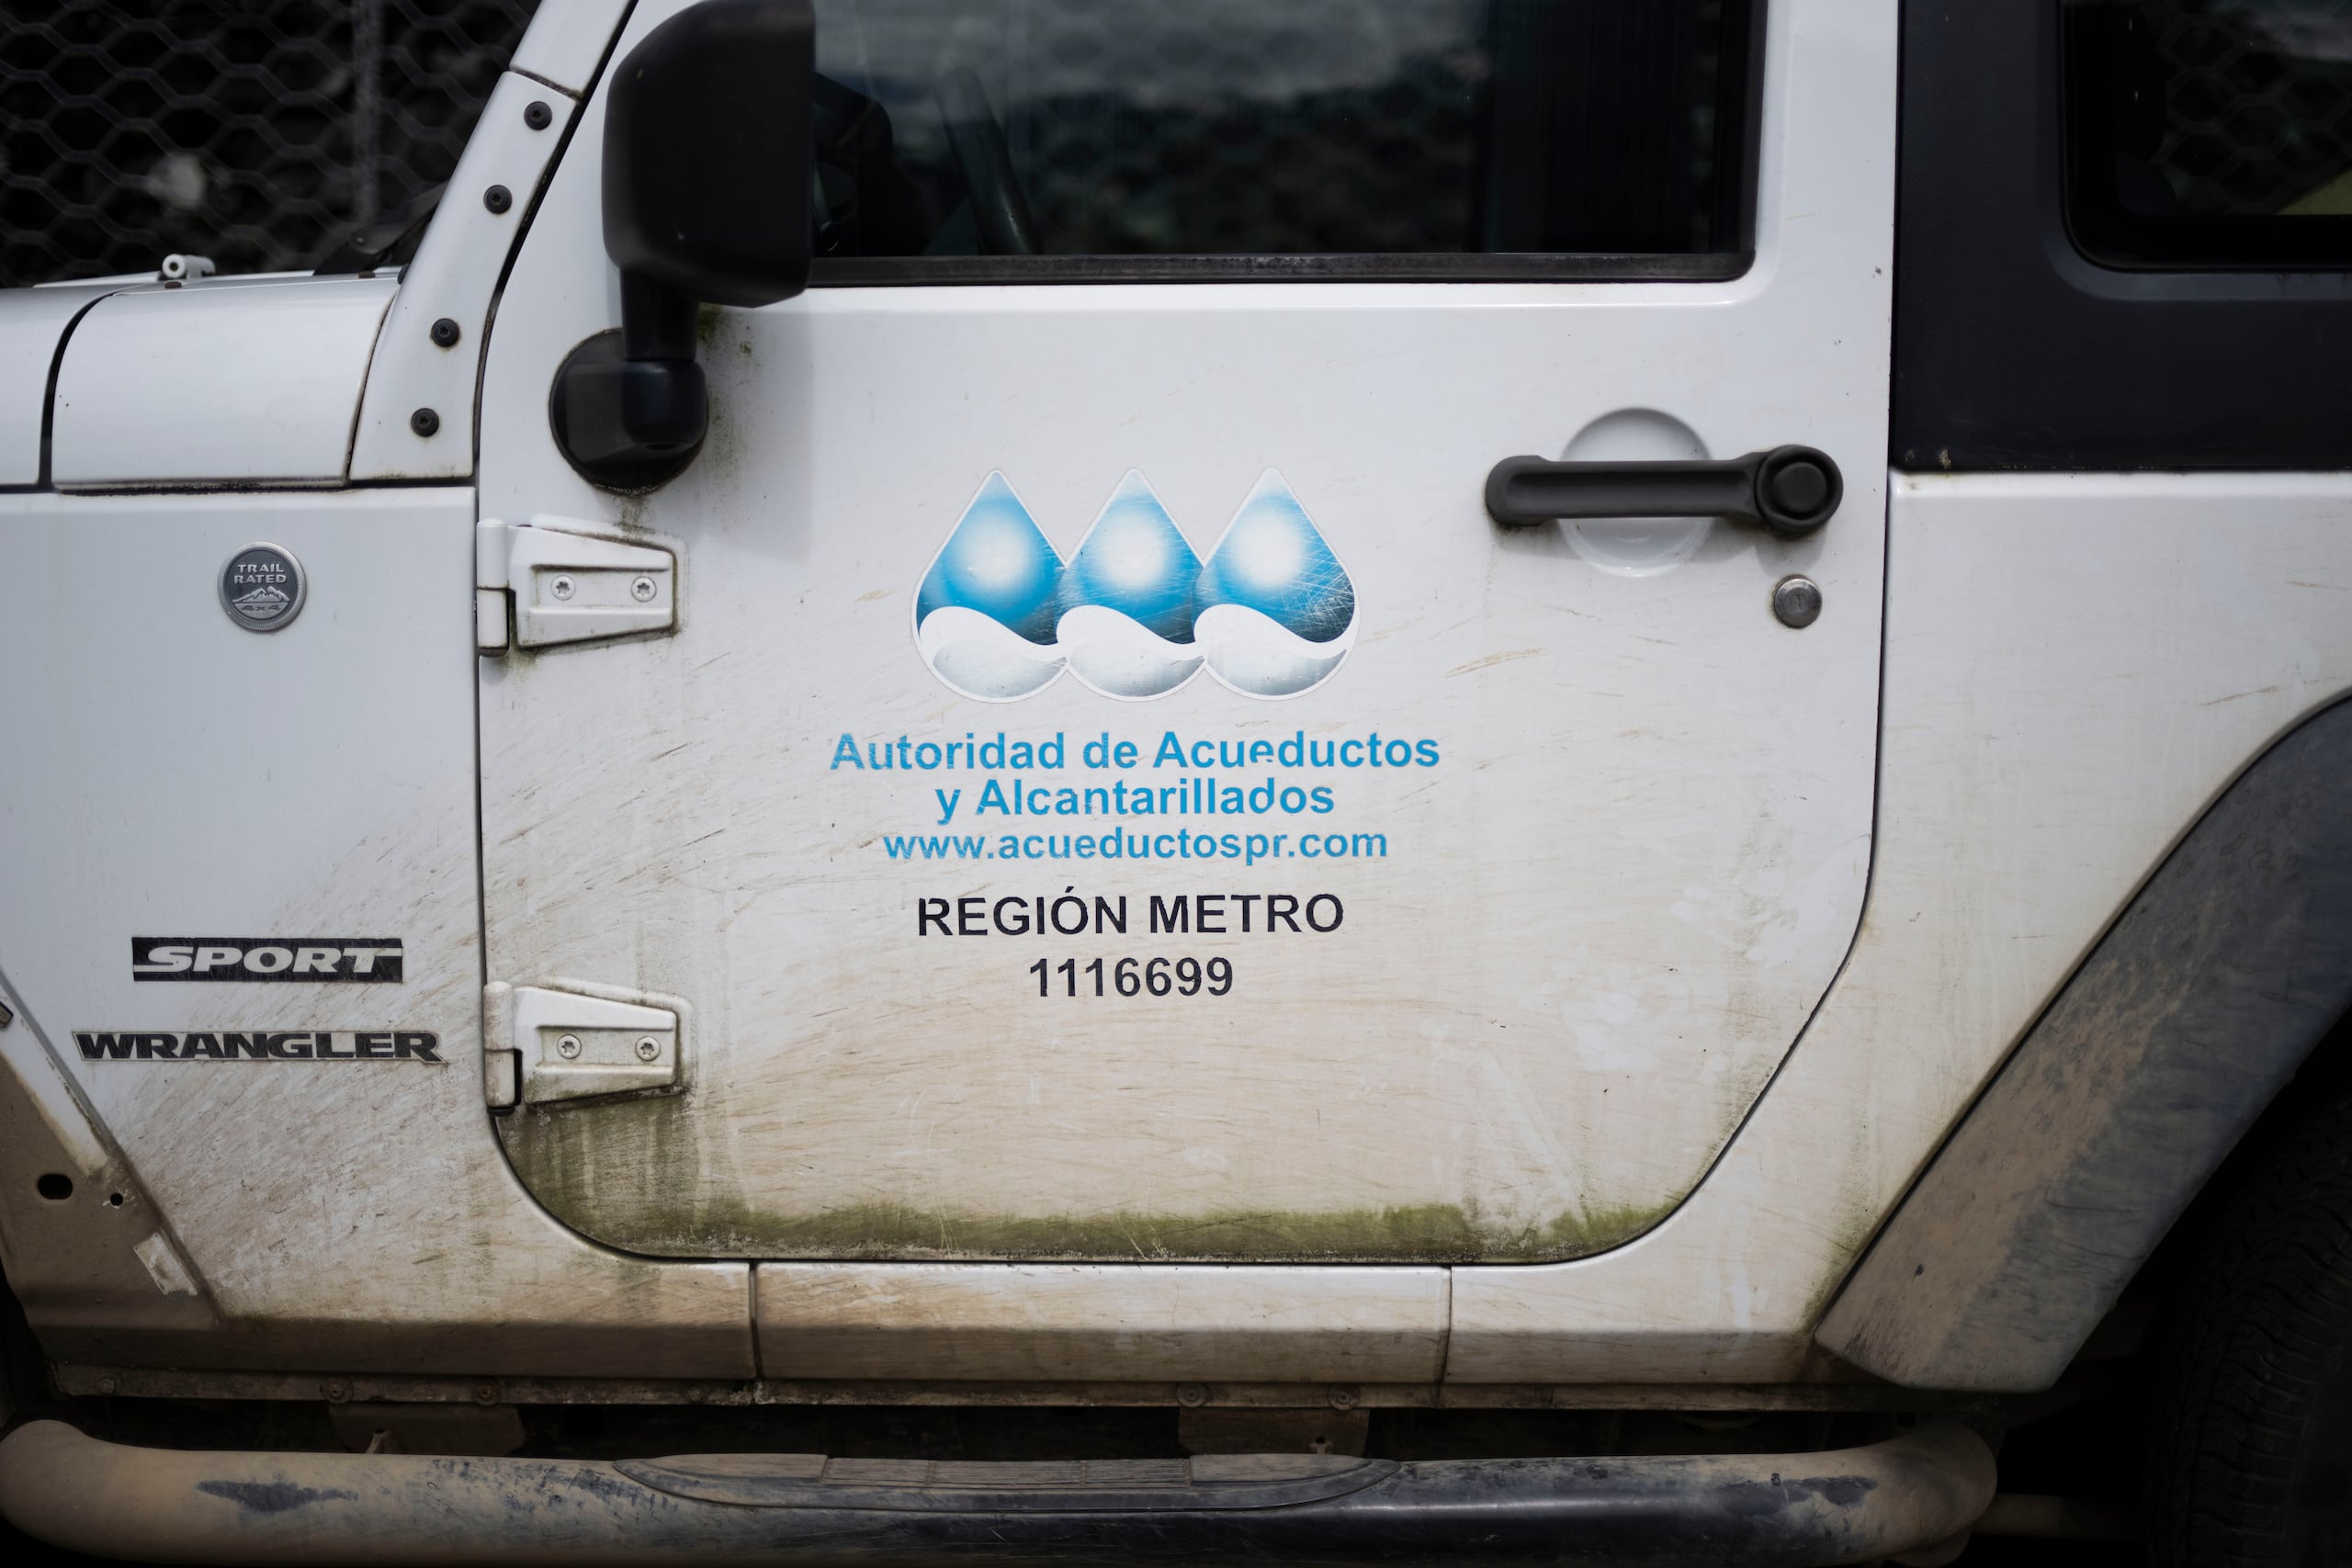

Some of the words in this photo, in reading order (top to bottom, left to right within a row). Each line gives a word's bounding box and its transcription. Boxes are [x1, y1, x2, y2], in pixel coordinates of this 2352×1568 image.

[233, 574, 287, 584] RATED
[237, 563, 285, 573] TRAIL
[831, 732, 1065, 770] Autoridad
[1082, 732, 1137, 769] de
[1153, 730, 1440, 768] Acueductos
[935, 789, 961, 825] y
[977, 778, 1335, 815] Alcantarillados
[884, 827, 1386, 865] www.acueductospr.com
[918, 886, 1126, 936] REGIÓN
[1149, 894, 1344, 933] METRO
[133, 946, 402, 974] SPORT
[1029, 956, 1233, 997] 1116699
[75, 1032, 445, 1062] WRANGLER
